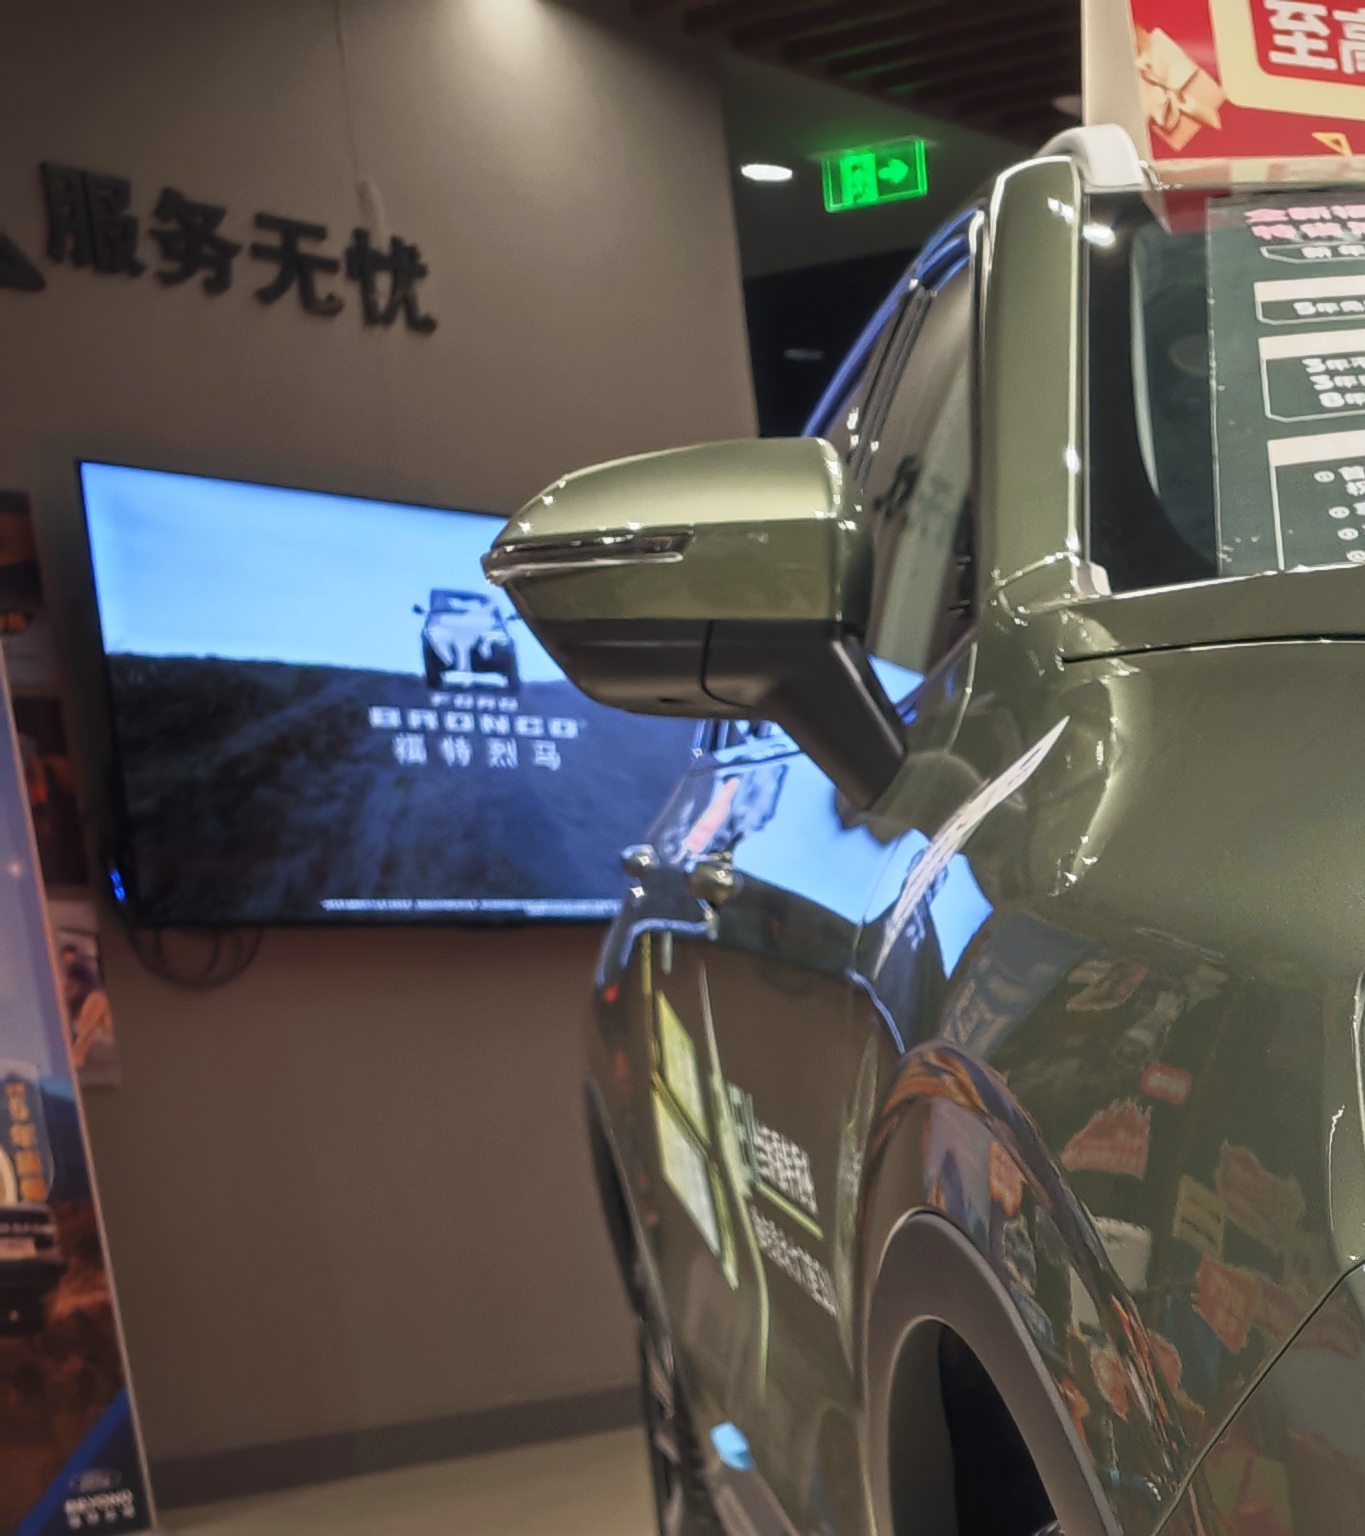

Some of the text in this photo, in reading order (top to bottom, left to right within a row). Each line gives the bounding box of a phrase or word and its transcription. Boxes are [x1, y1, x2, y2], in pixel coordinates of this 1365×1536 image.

[41, 162, 437, 334] 服务无忧
[368, 705, 579, 739] BRONCO
[392, 733, 563, 771] 福特烈马
